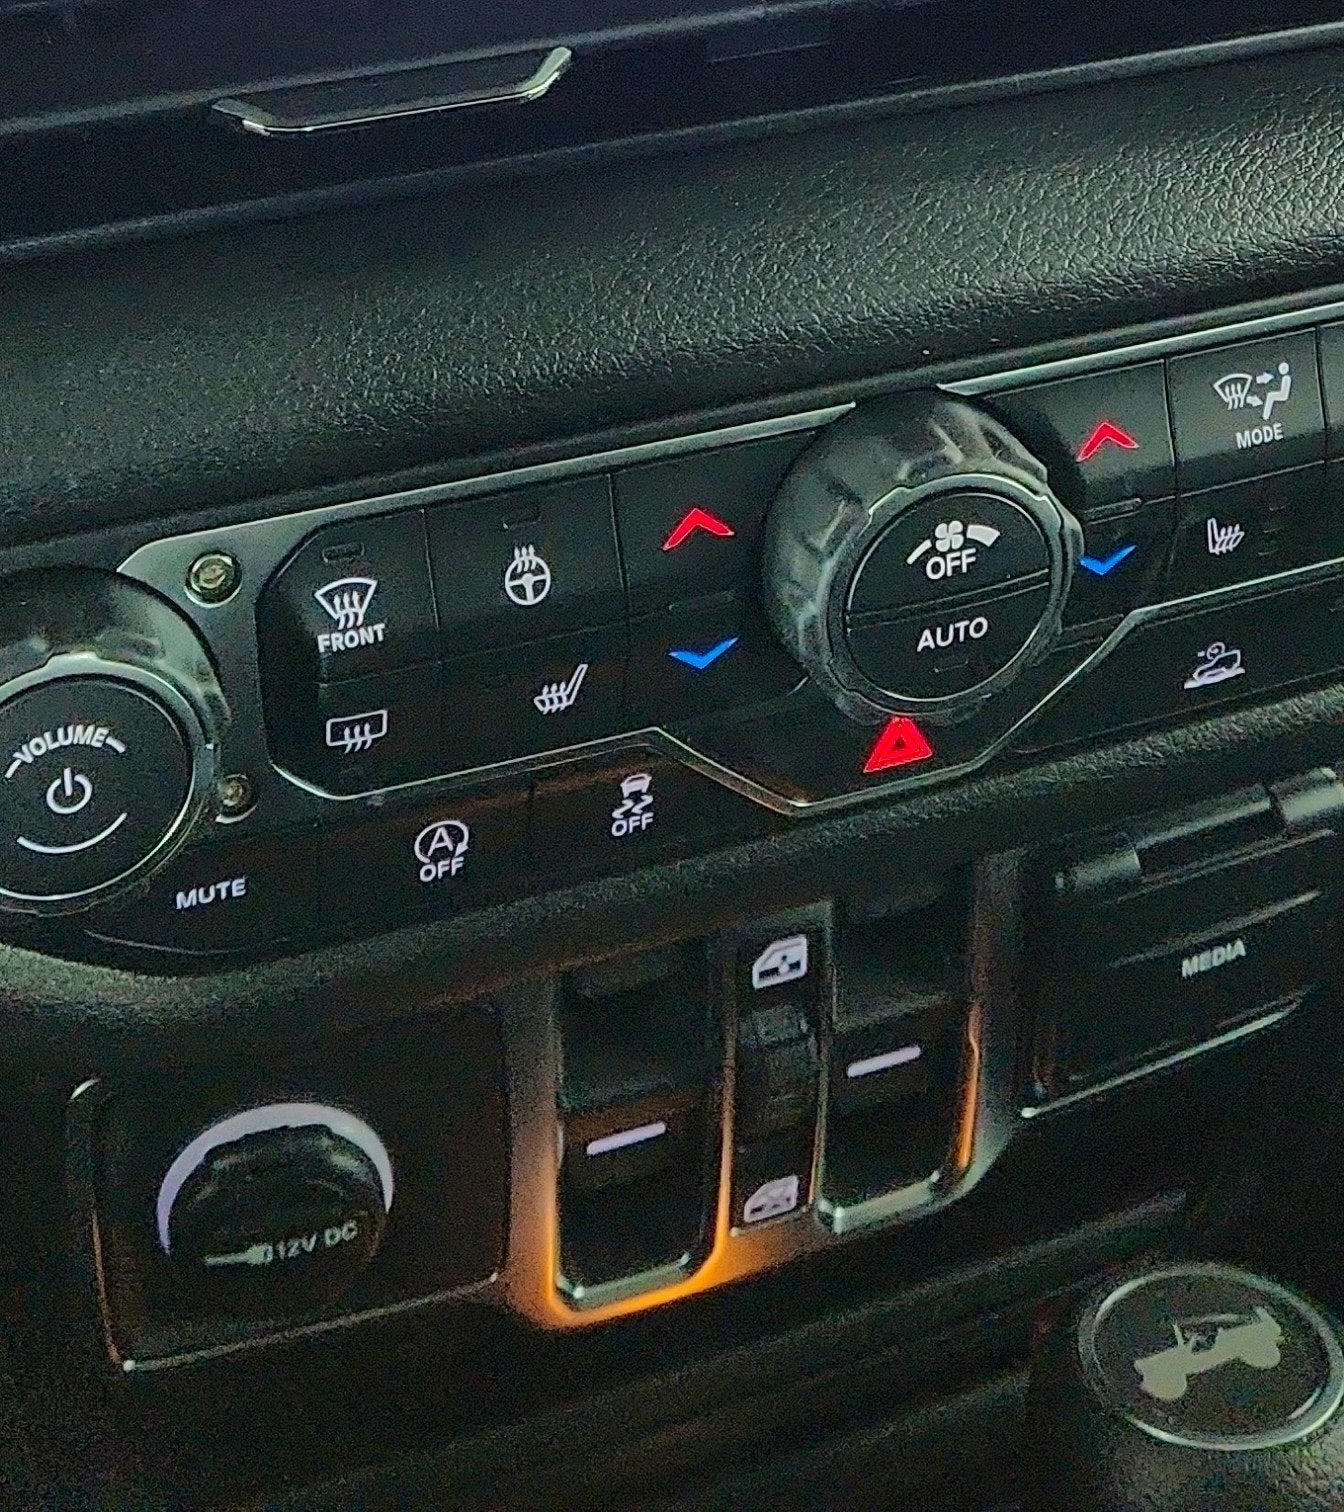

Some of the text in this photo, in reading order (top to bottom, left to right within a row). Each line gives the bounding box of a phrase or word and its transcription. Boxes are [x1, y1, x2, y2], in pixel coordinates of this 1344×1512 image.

[1236, 423, 1284, 450] MODE
[925, 547, 977, 581] OFF
[317, 622, 386, 654] FRONT
[916, 615, 989, 653] AUTO
[13, 724, 110, 766] VOLUME
[611, 810, 654, 838] OFF
[419, 856, 464, 883] OFF
[175, 877, 248, 910] MUTE
[1181, 938, 1247, 979] MEDIA
